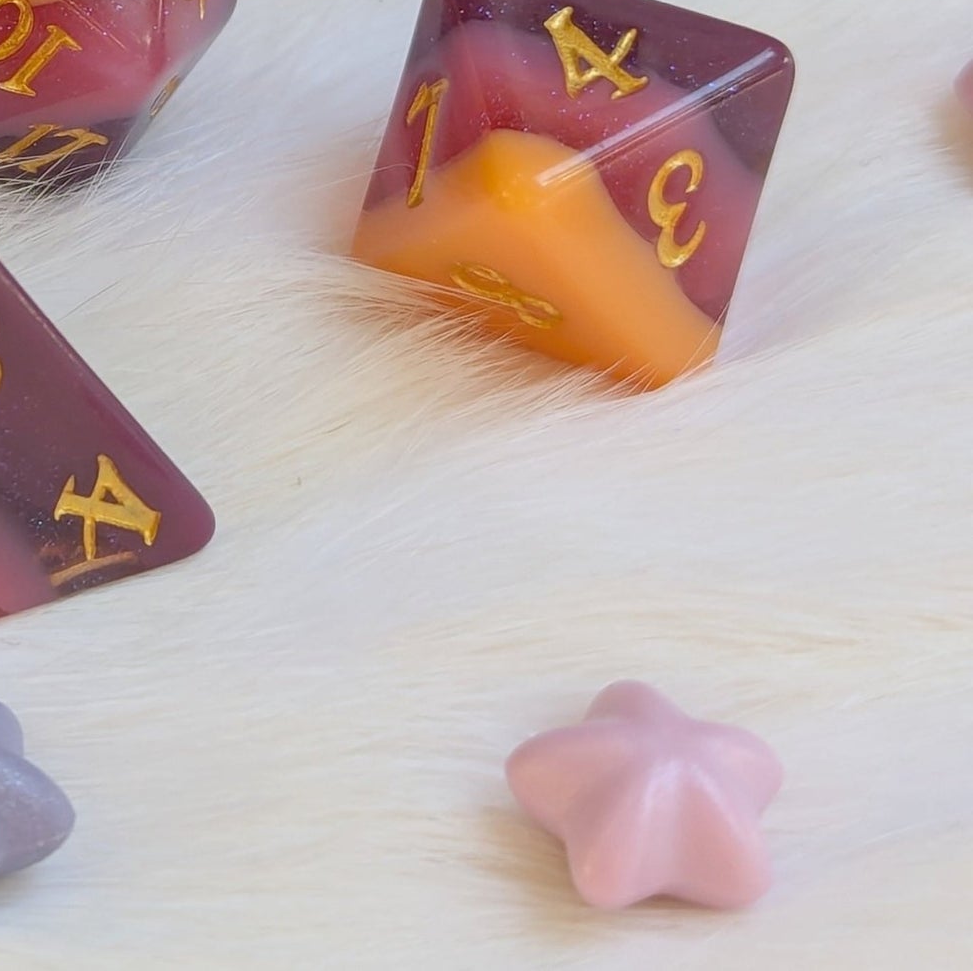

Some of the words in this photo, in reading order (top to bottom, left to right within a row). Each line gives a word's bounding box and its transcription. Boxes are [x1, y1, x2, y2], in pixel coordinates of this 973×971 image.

[542, 5, 650, 101] 4
[647, 148, 707, 269] 3
[53, 453, 162, 552] 4
